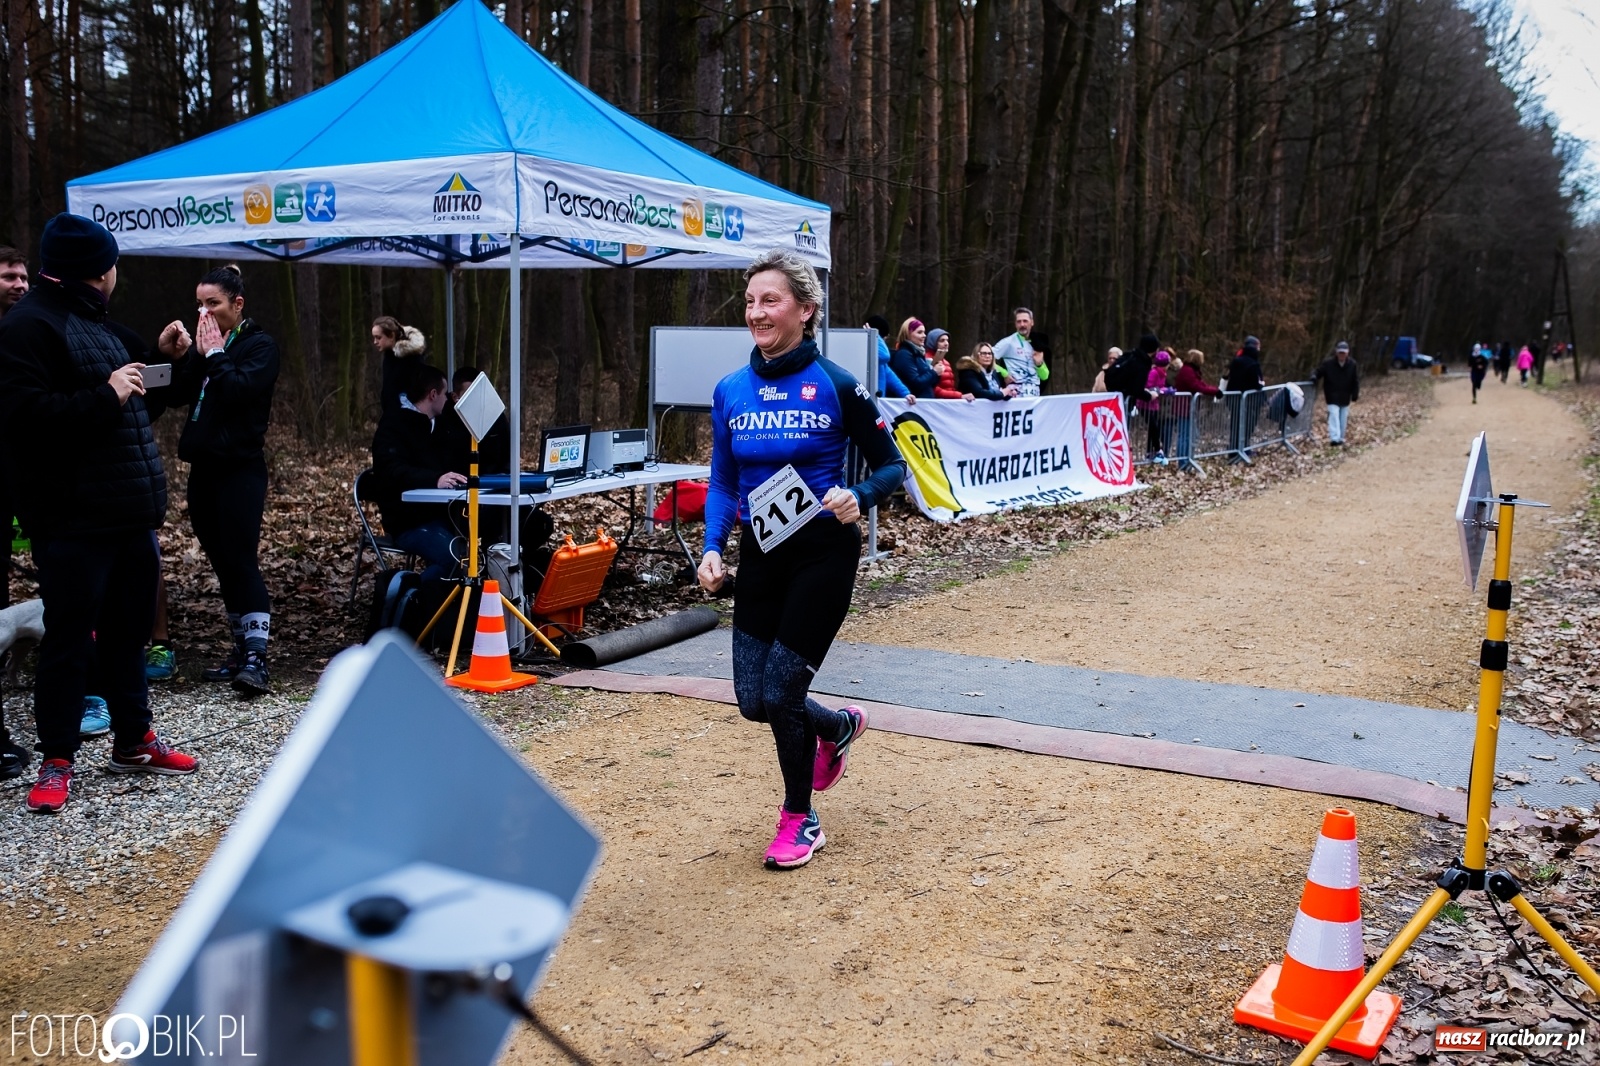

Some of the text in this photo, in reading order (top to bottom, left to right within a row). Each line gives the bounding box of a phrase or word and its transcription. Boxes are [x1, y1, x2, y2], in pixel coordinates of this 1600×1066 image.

[93, 195, 236, 232] PersonalBest
[433, 194, 482, 213] MITKO
[544, 180, 677, 230] PersonalBest
[992, 409, 1034, 439] BIEG
[956, 444, 1072, 488] TWARDZIELA
[753, 486, 814, 542] 212
